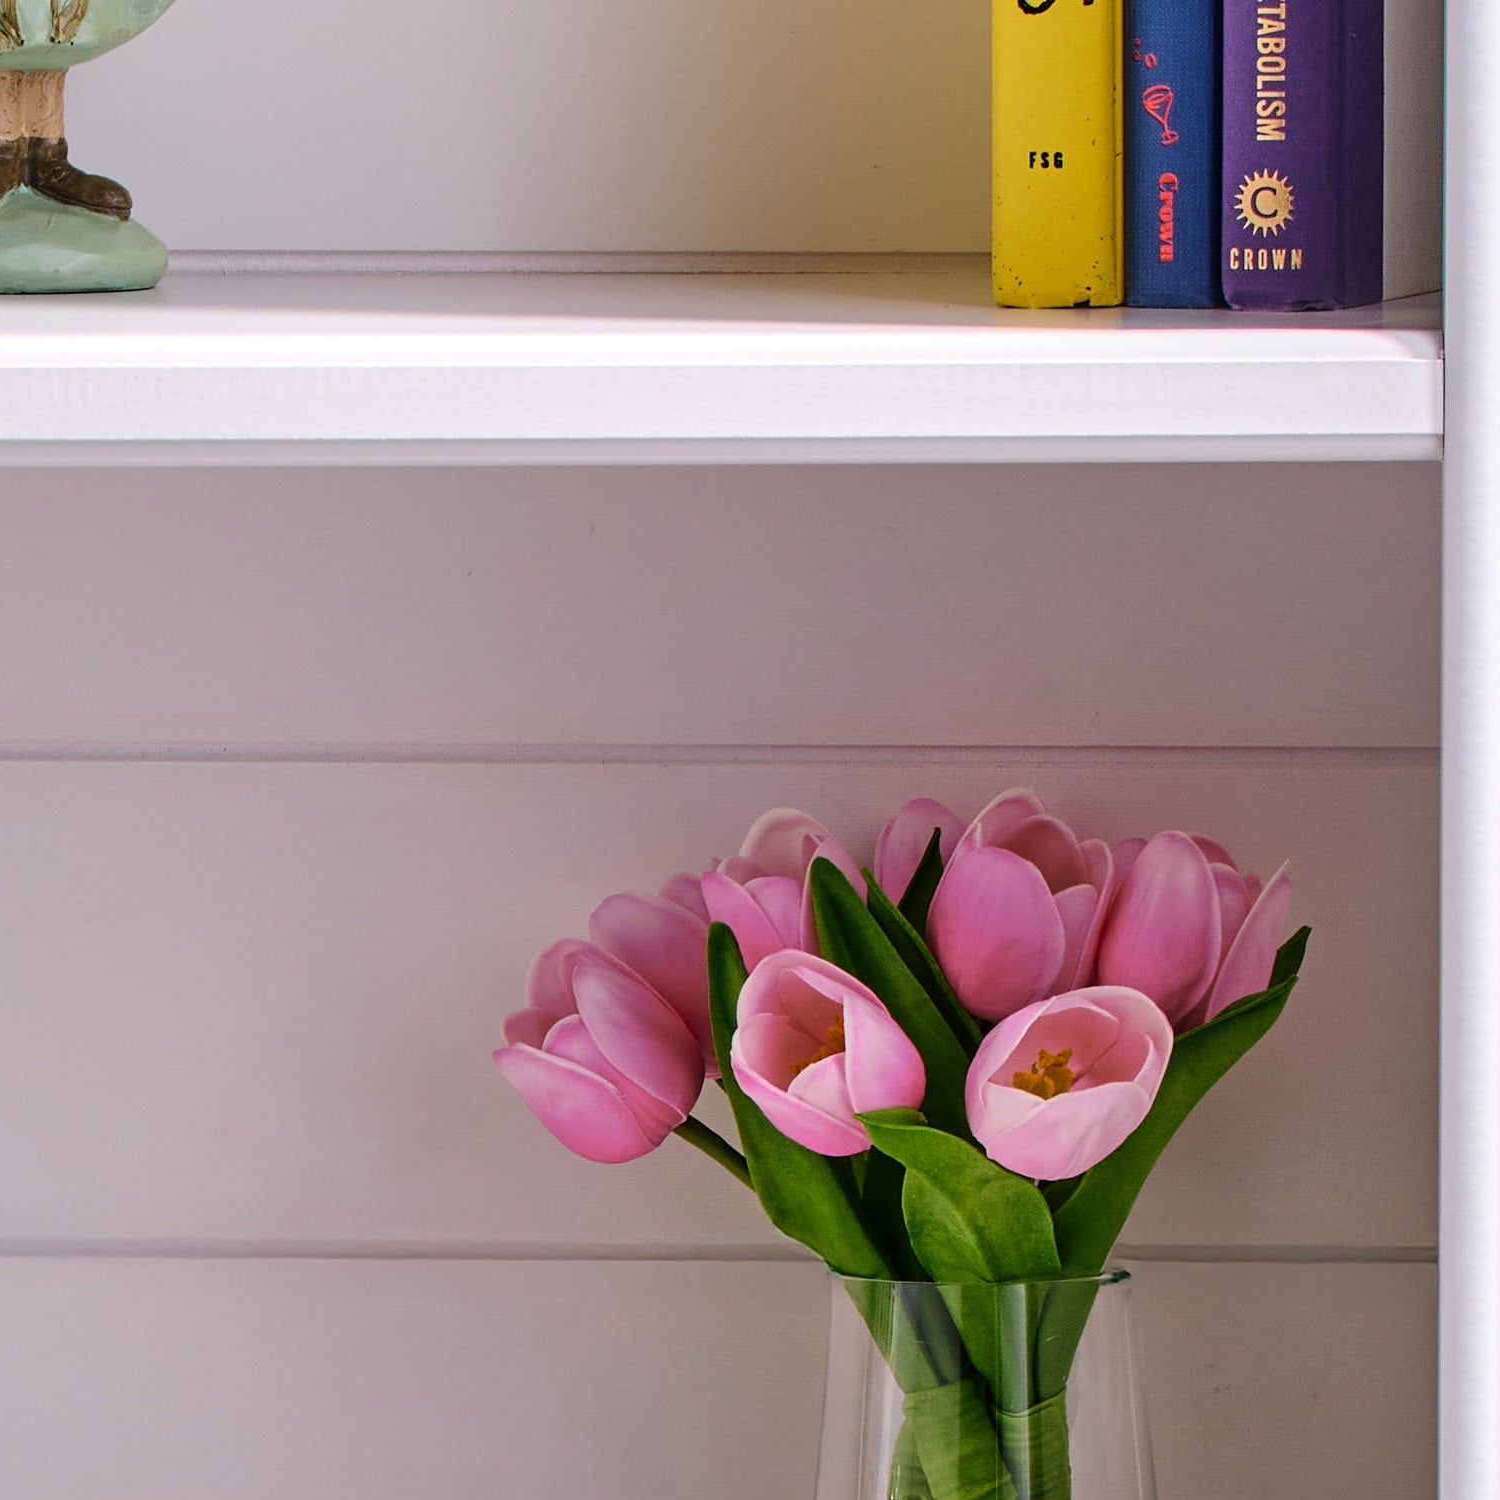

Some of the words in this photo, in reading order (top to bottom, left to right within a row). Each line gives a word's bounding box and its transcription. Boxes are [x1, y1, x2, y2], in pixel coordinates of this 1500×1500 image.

[1257, 0, 1285, 141] TABOLISM
[1029, 151, 1063, 169] FSG
[1229, 247, 1303, 270] CROWN
